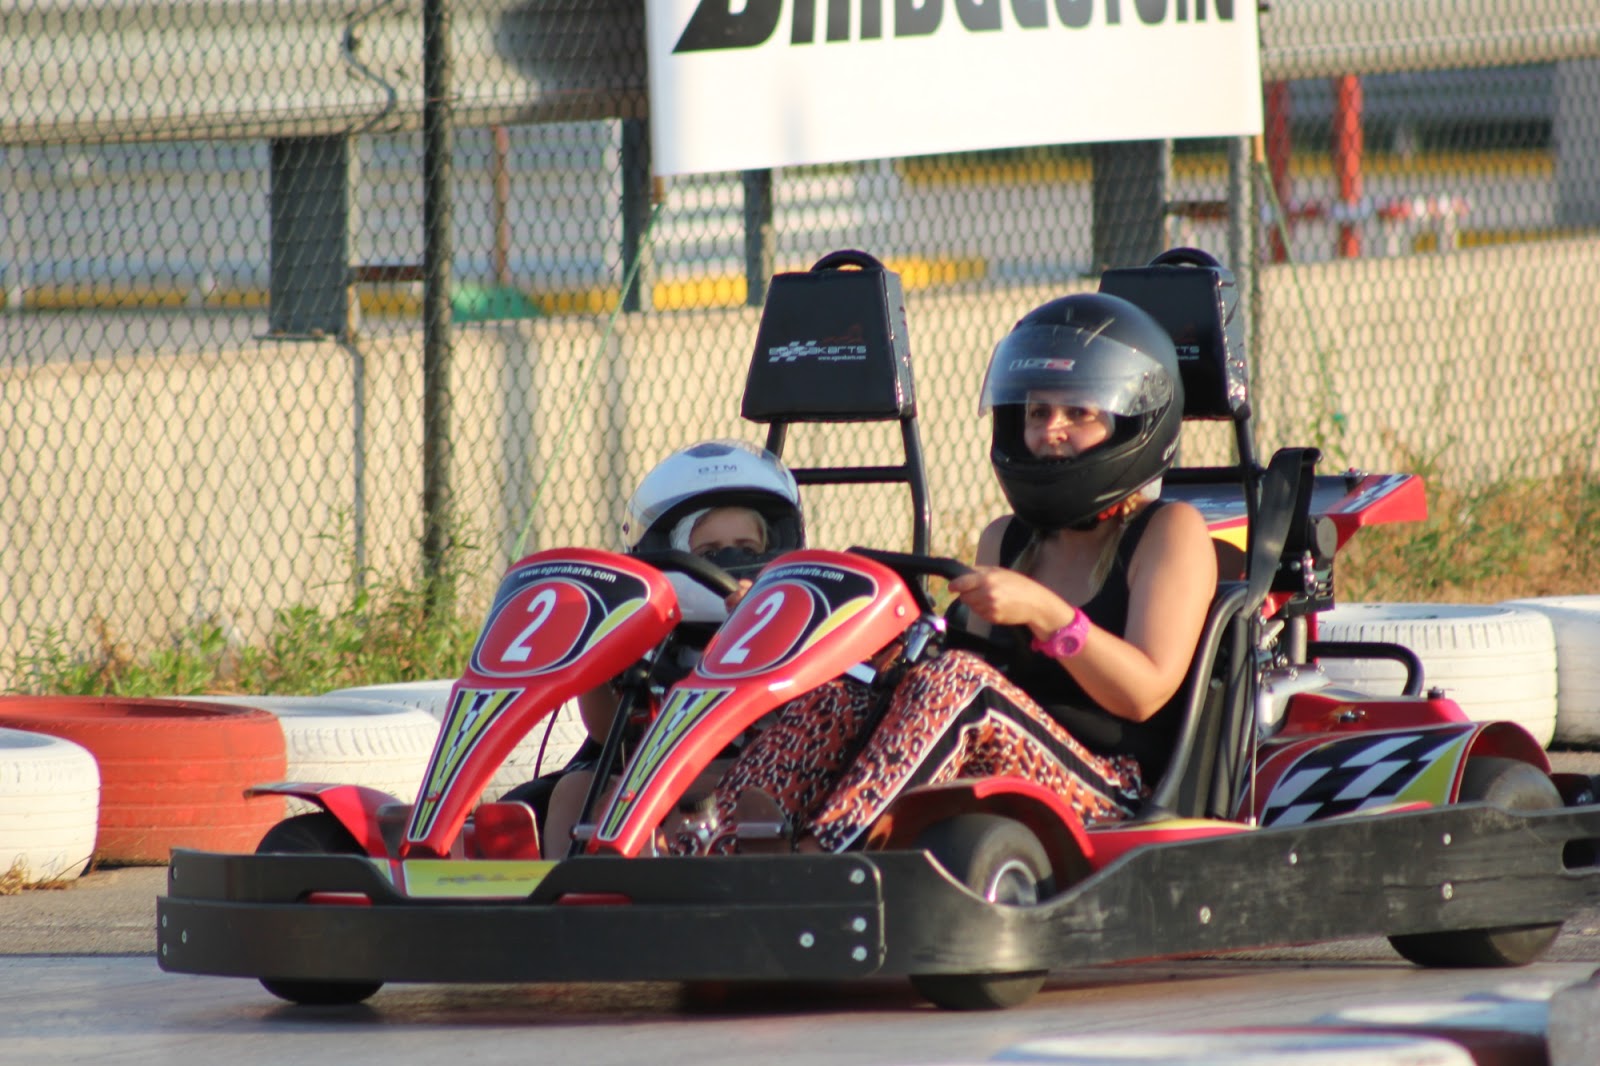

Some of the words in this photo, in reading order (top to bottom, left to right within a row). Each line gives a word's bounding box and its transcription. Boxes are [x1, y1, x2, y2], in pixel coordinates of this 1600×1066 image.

[519, 565, 617, 583] www.egarakarts.com
[500, 589, 557, 662] 2
[720, 591, 785, 664] 2
